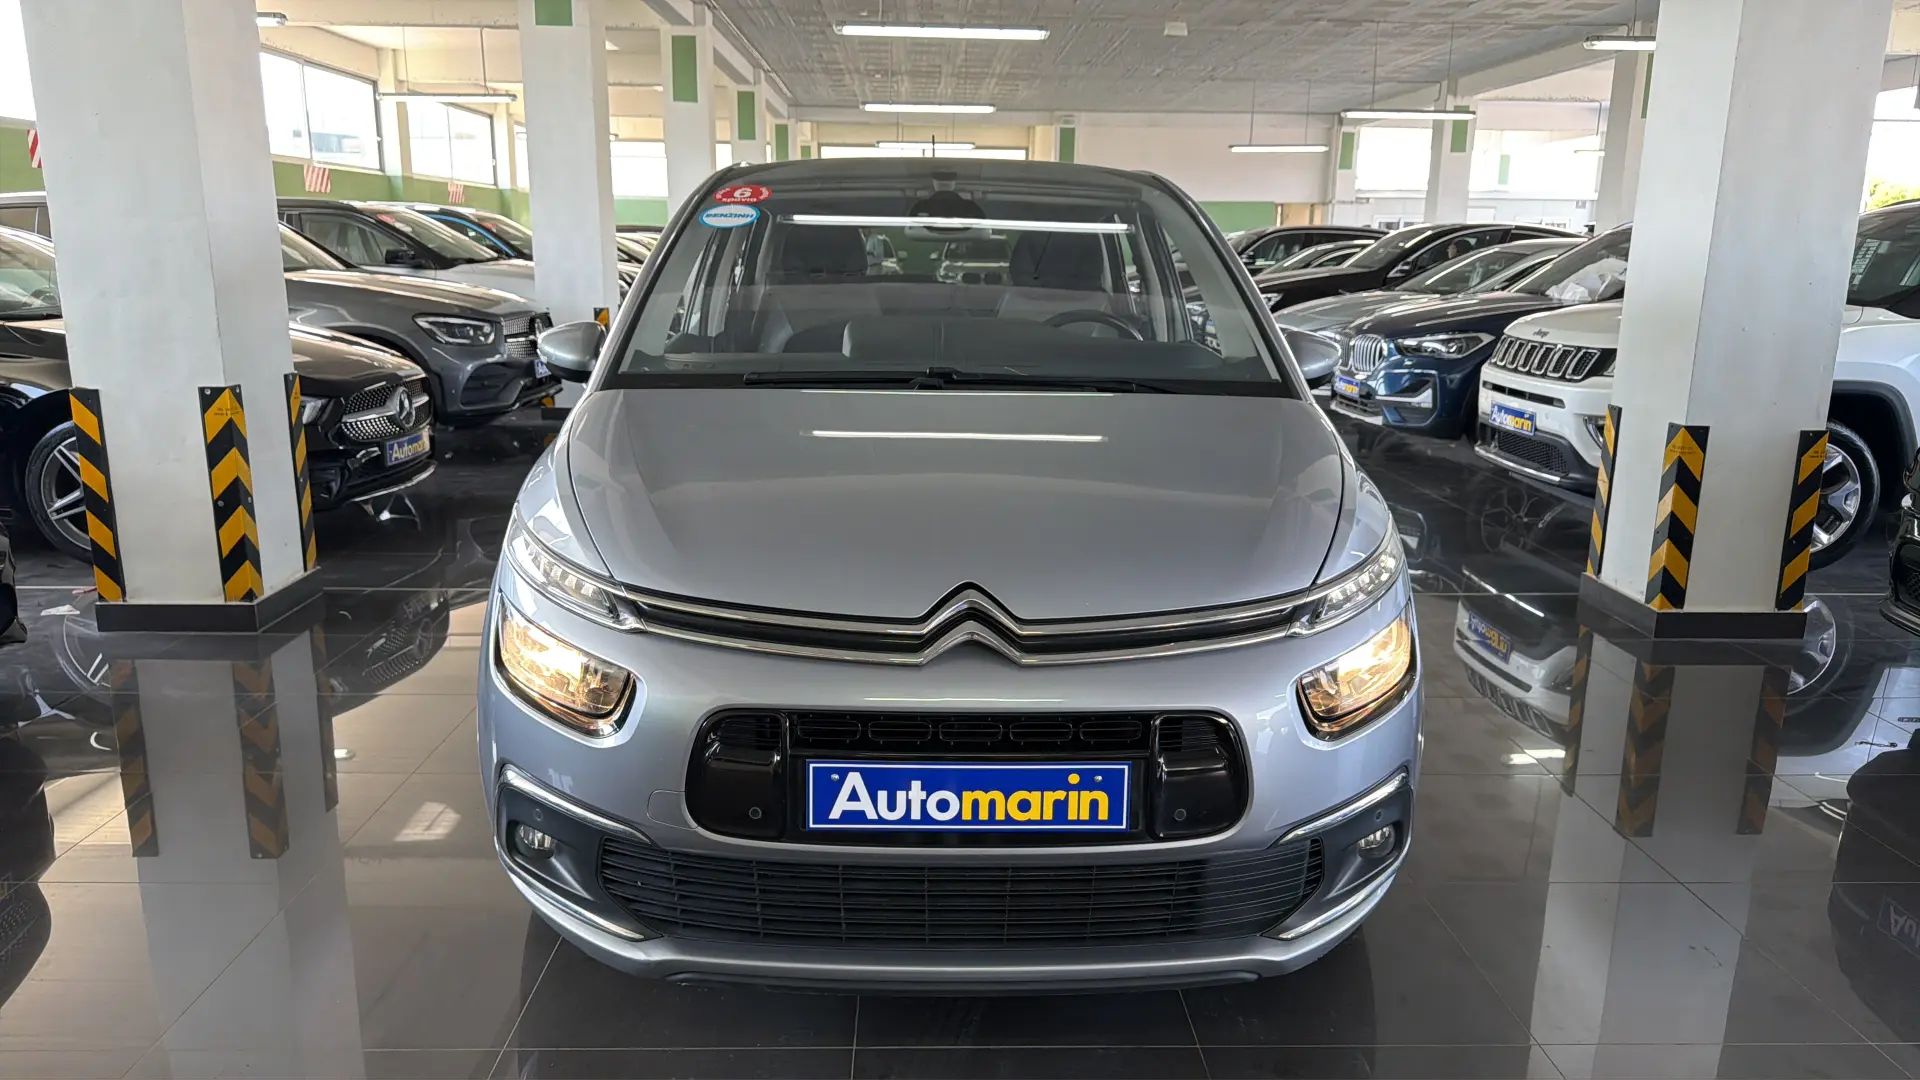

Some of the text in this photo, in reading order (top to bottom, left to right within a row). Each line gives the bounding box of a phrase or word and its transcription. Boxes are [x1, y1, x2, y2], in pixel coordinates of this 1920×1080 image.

[734, 187, 753, 198] 6
[1491, 405, 1532, 432] Automarin
[828, 772, 1108, 820] Automarin
